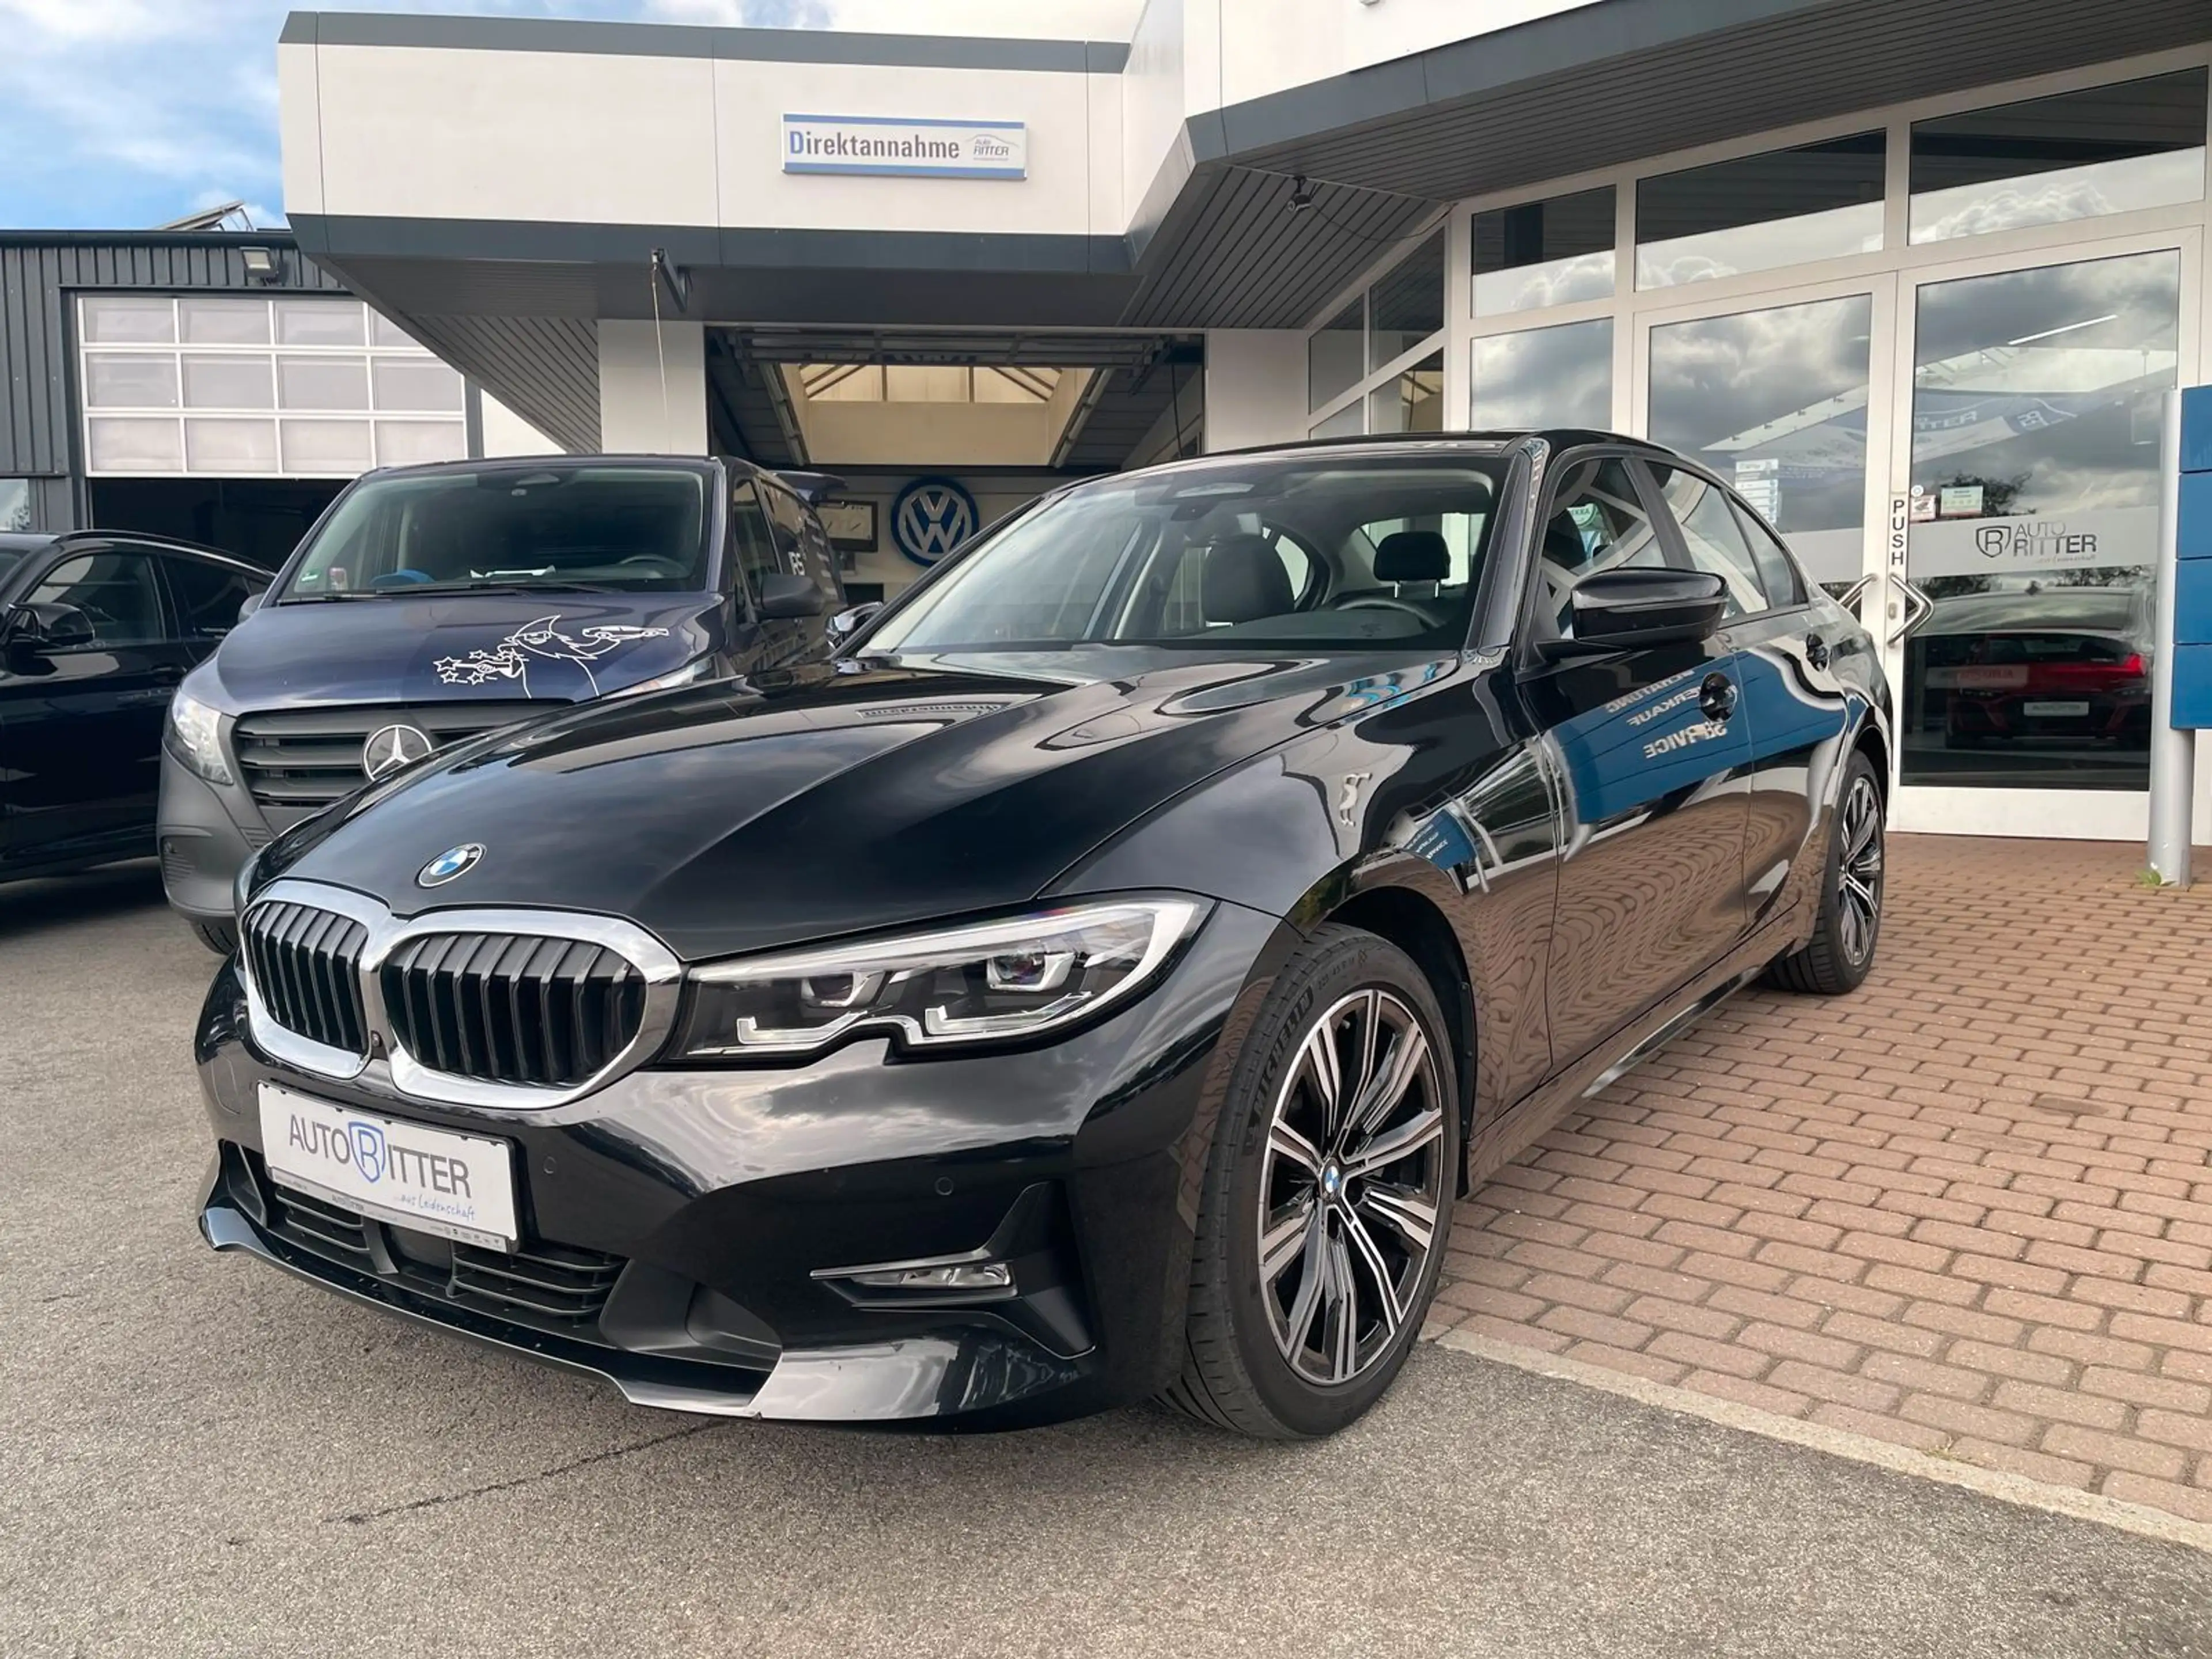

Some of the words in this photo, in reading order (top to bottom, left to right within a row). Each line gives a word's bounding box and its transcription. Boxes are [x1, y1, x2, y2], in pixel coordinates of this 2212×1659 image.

[789, 131, 960, 158] Direktannahme
[974, 145, 1009, 156] RITTER
[1891, 499, 1905, 565] PUSH
[2016, 521, 2066, 538] AUTO
[2014, 534, 2097, 556] RITTER
